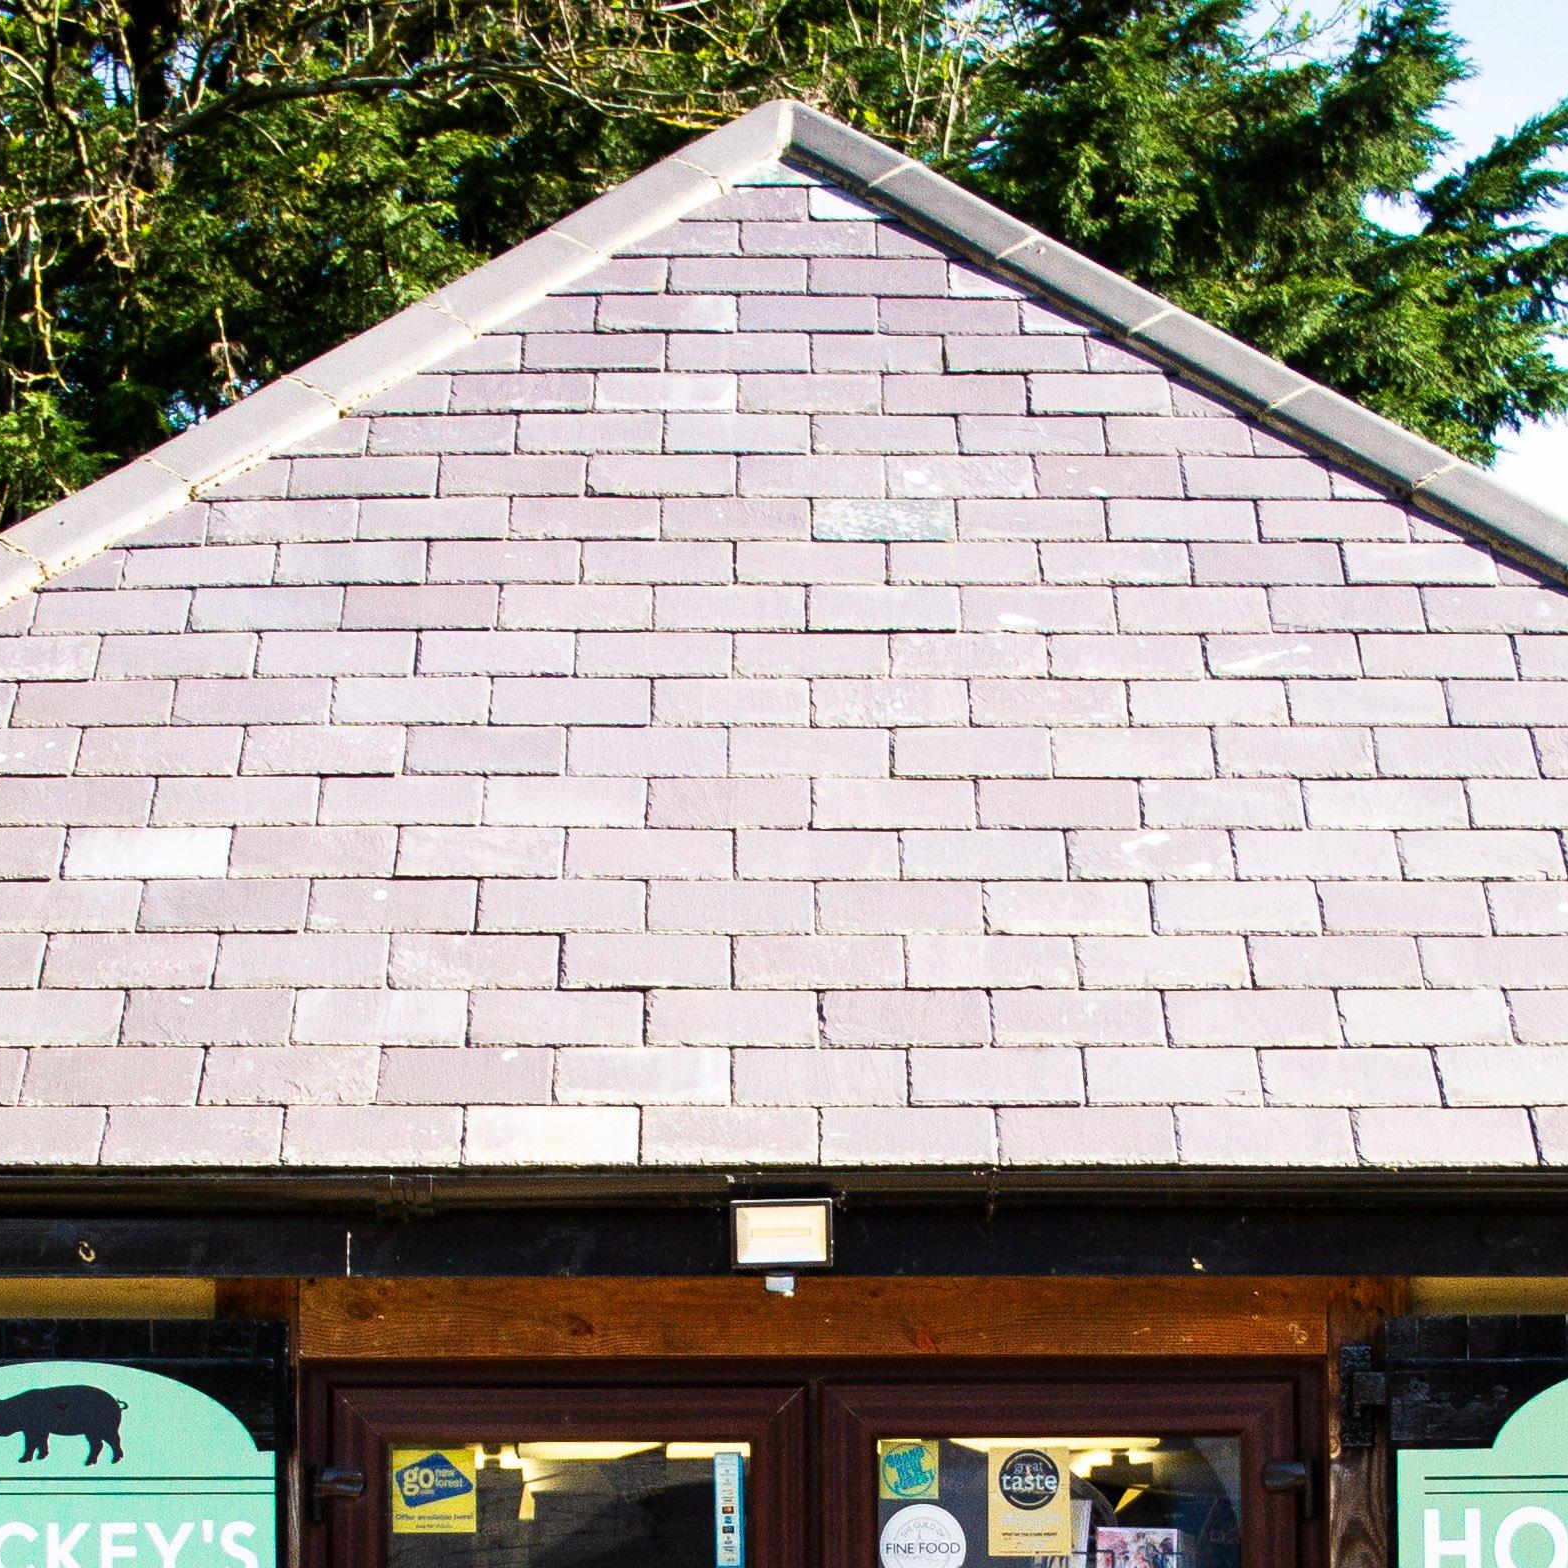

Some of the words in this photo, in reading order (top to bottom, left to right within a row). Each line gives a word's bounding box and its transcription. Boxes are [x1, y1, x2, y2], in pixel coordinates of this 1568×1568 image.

[403, 1466, 435, 1497] go
[1001, 1473, 1058, 1491] taste
[885, 1542, 915, 1555] FINE
[919, 1541, 961, 1554] FOOD
